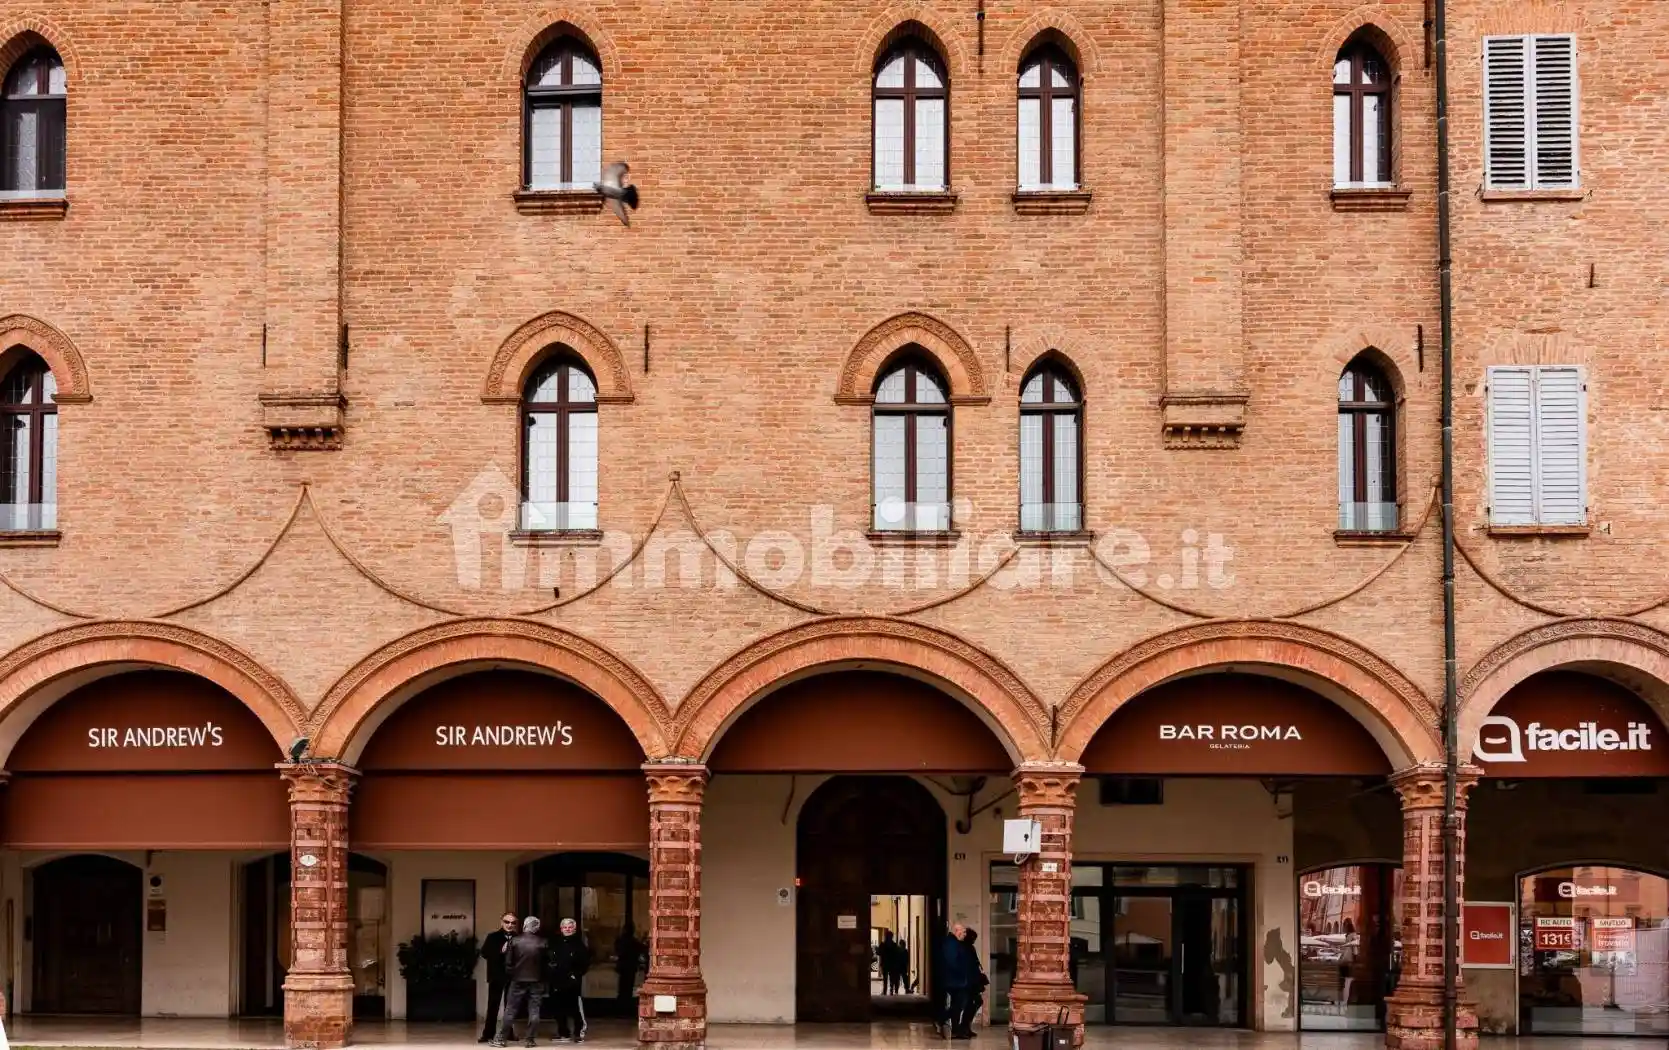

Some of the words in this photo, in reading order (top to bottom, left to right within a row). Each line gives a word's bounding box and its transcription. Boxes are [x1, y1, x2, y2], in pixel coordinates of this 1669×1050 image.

[88, 727, 119, 748] SIR
[123, 721, 223, 748] ANDREW'S
[435, 726, 467, 746] SIR
[471, 720, 573, 746] ANDREW'S
[1159, 724, 1214, 741] BAR
[1221, 724, 1302, 741] ROMA
[1525, 721, 1652, 751] facile.it
